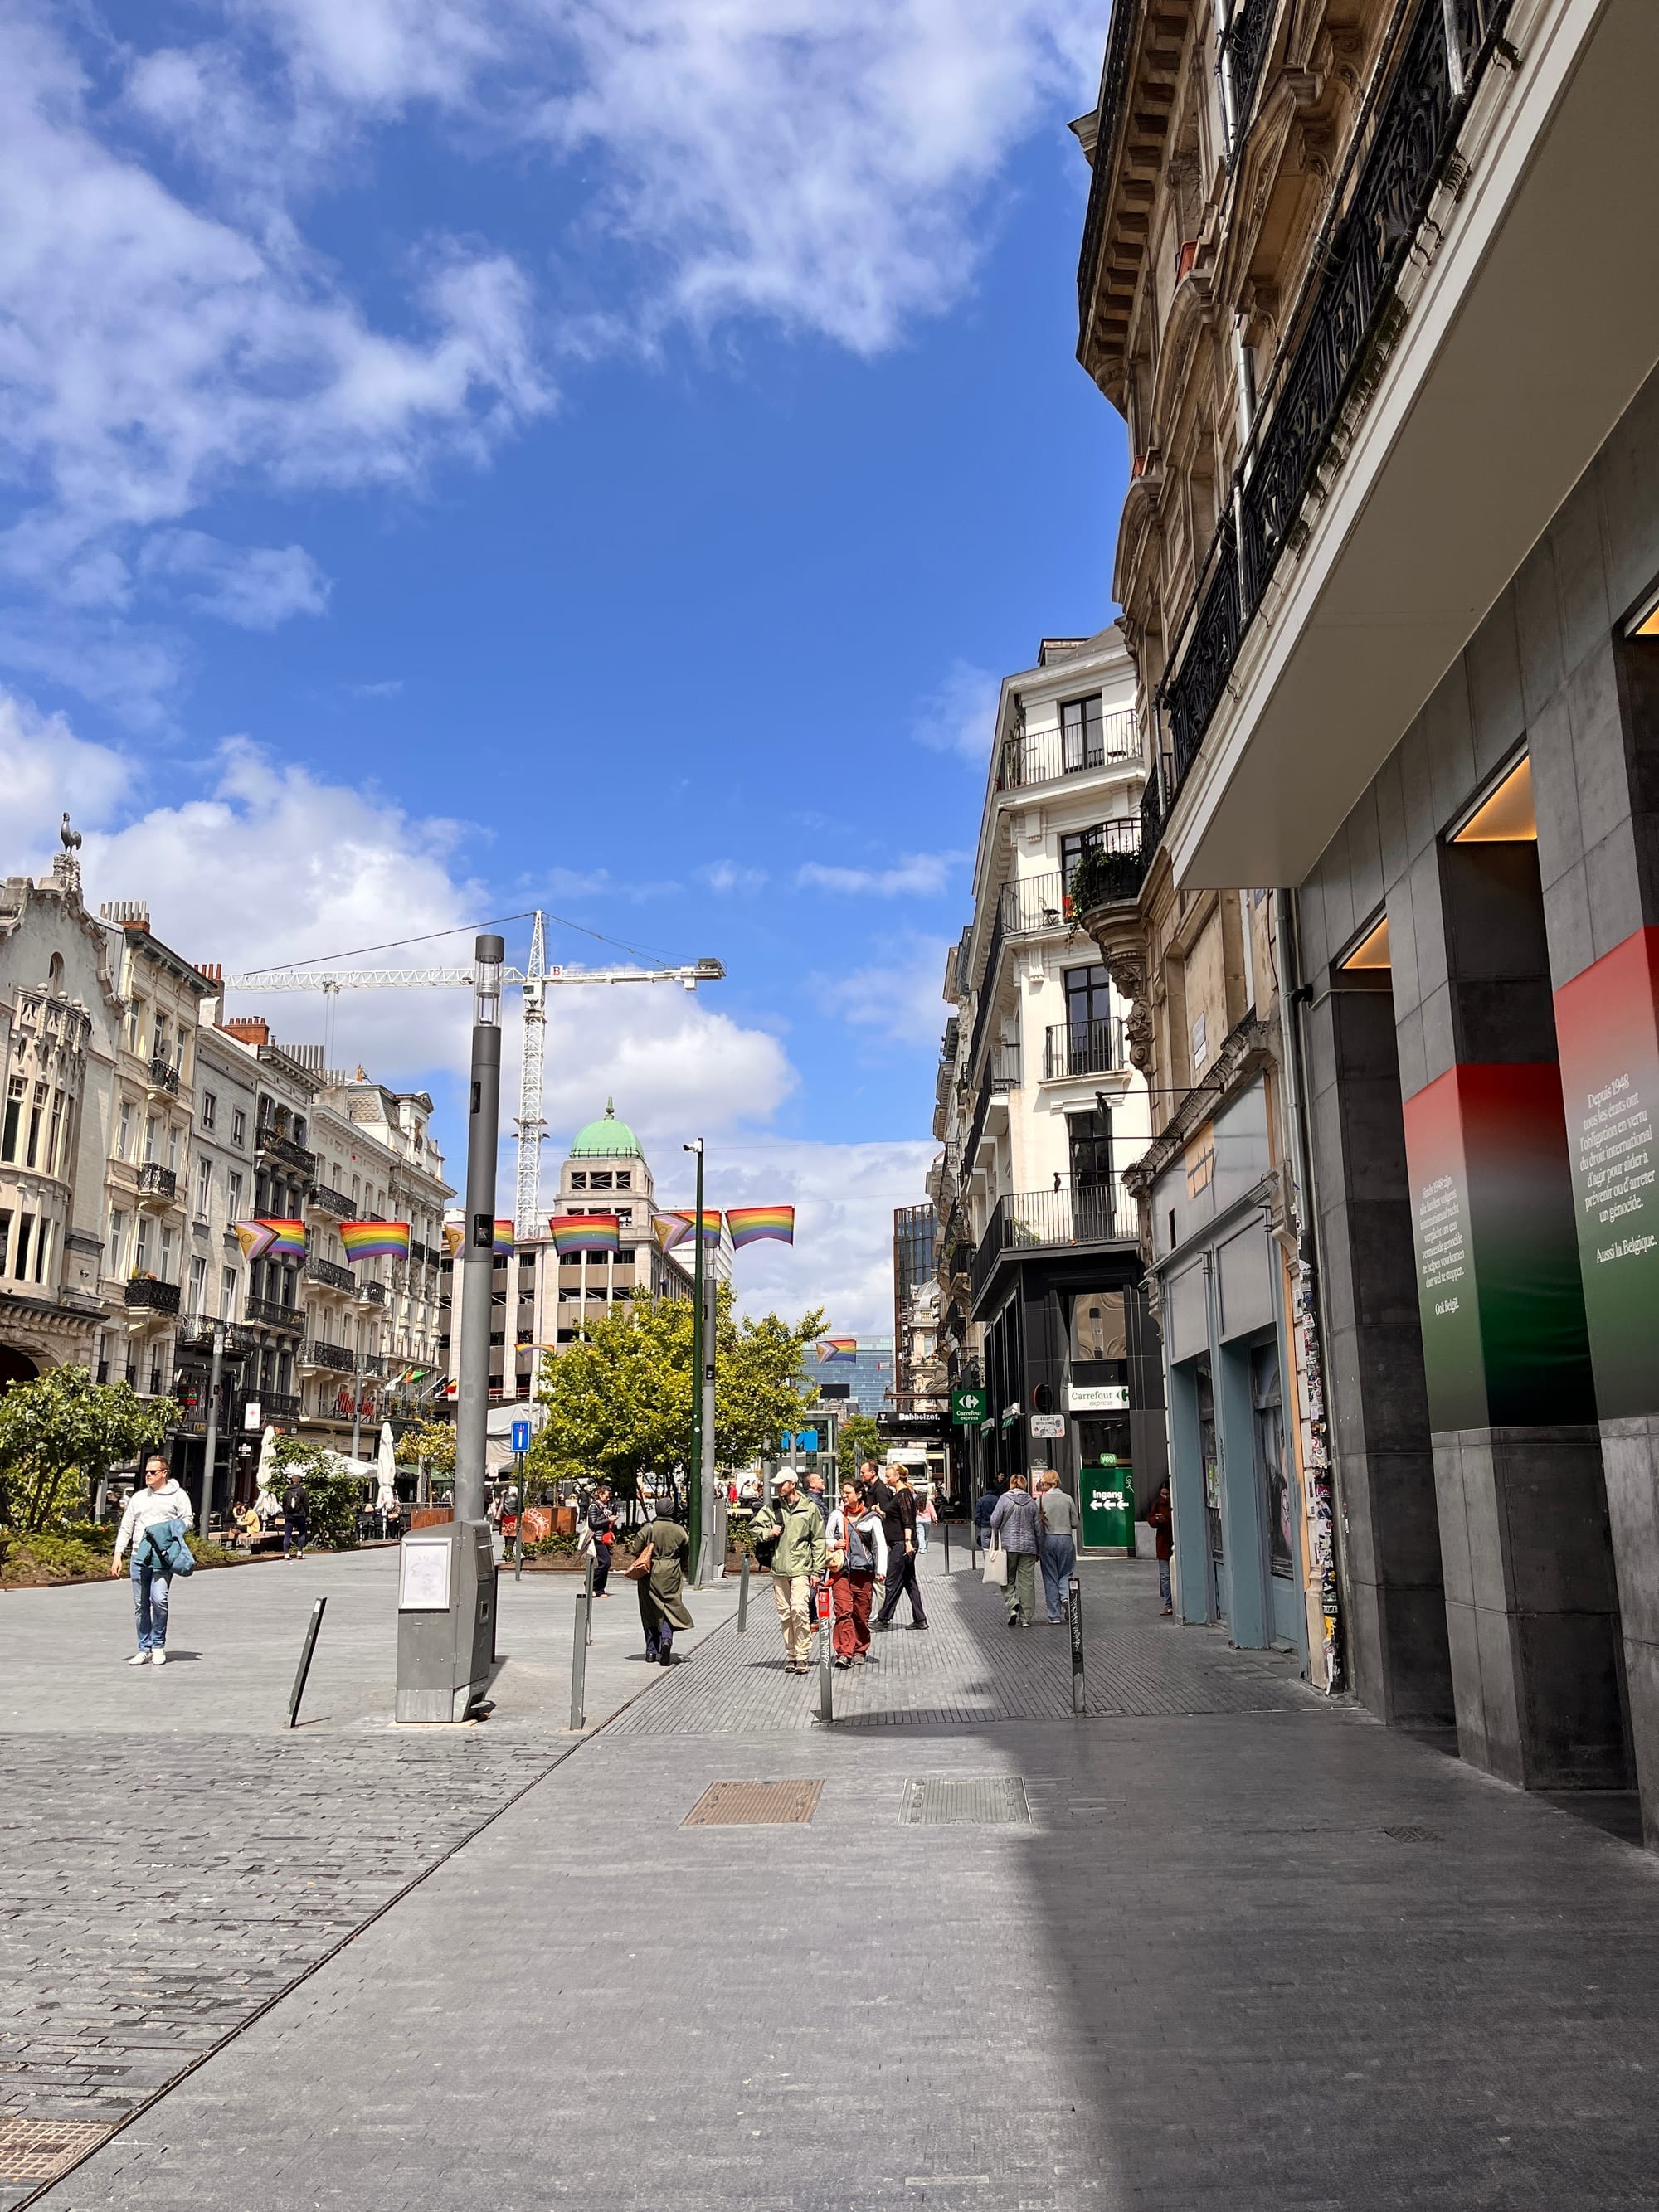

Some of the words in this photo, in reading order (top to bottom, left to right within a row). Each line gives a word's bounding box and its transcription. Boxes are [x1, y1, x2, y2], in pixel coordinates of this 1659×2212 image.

[1588, 1085, 1612, 1108] Depuis
[1612, 1073, 1630, 1096] 1948
[1584, 1115, 1598, 1130] tous
[1598, 1109, 1608, 1123] les
[1626, 1092, 1640, 1108] ont
[1579, 1125, 1618, 1152] l'obligation
[1618, 1121, 1627, 1133] en
[1627, 1110, 1648, 1128] vertu
[1579, 1156, 1589, 1171] du
[1589, 1147, 1607, 1167] droit
[1606, 1124, 1652, 1159] international
[1587, 1168, 1607, 1188] d'agir
[1607, 1162, 1623, 1183] pour
[1624, 1153, 1642, 1172] aider
[1642, 1148, 1650, 1164] à
[1433, 1178, 1443, 1194] 1948
[1584, 1184, 1613, 1213] prévenir
[1613, 1183, 1623, 1196] ou
[1599, 1210, 1609, 1223] un
[1609, 1194, 1644, 1223] génocide.
[1443, 1232, 1463, 1253] genocide
[1596, 1244, 1615, 1264] Aussi
[1615, 1242, 1623, 1257] la
[1623, 1234, 1657, 1256] Belgique.
[1435, 1301, 1444, 1315] Ook
[1071, 1391, 1113, 1401] Carrefour
[1092, 1490, 1123, 1500] Ingang
